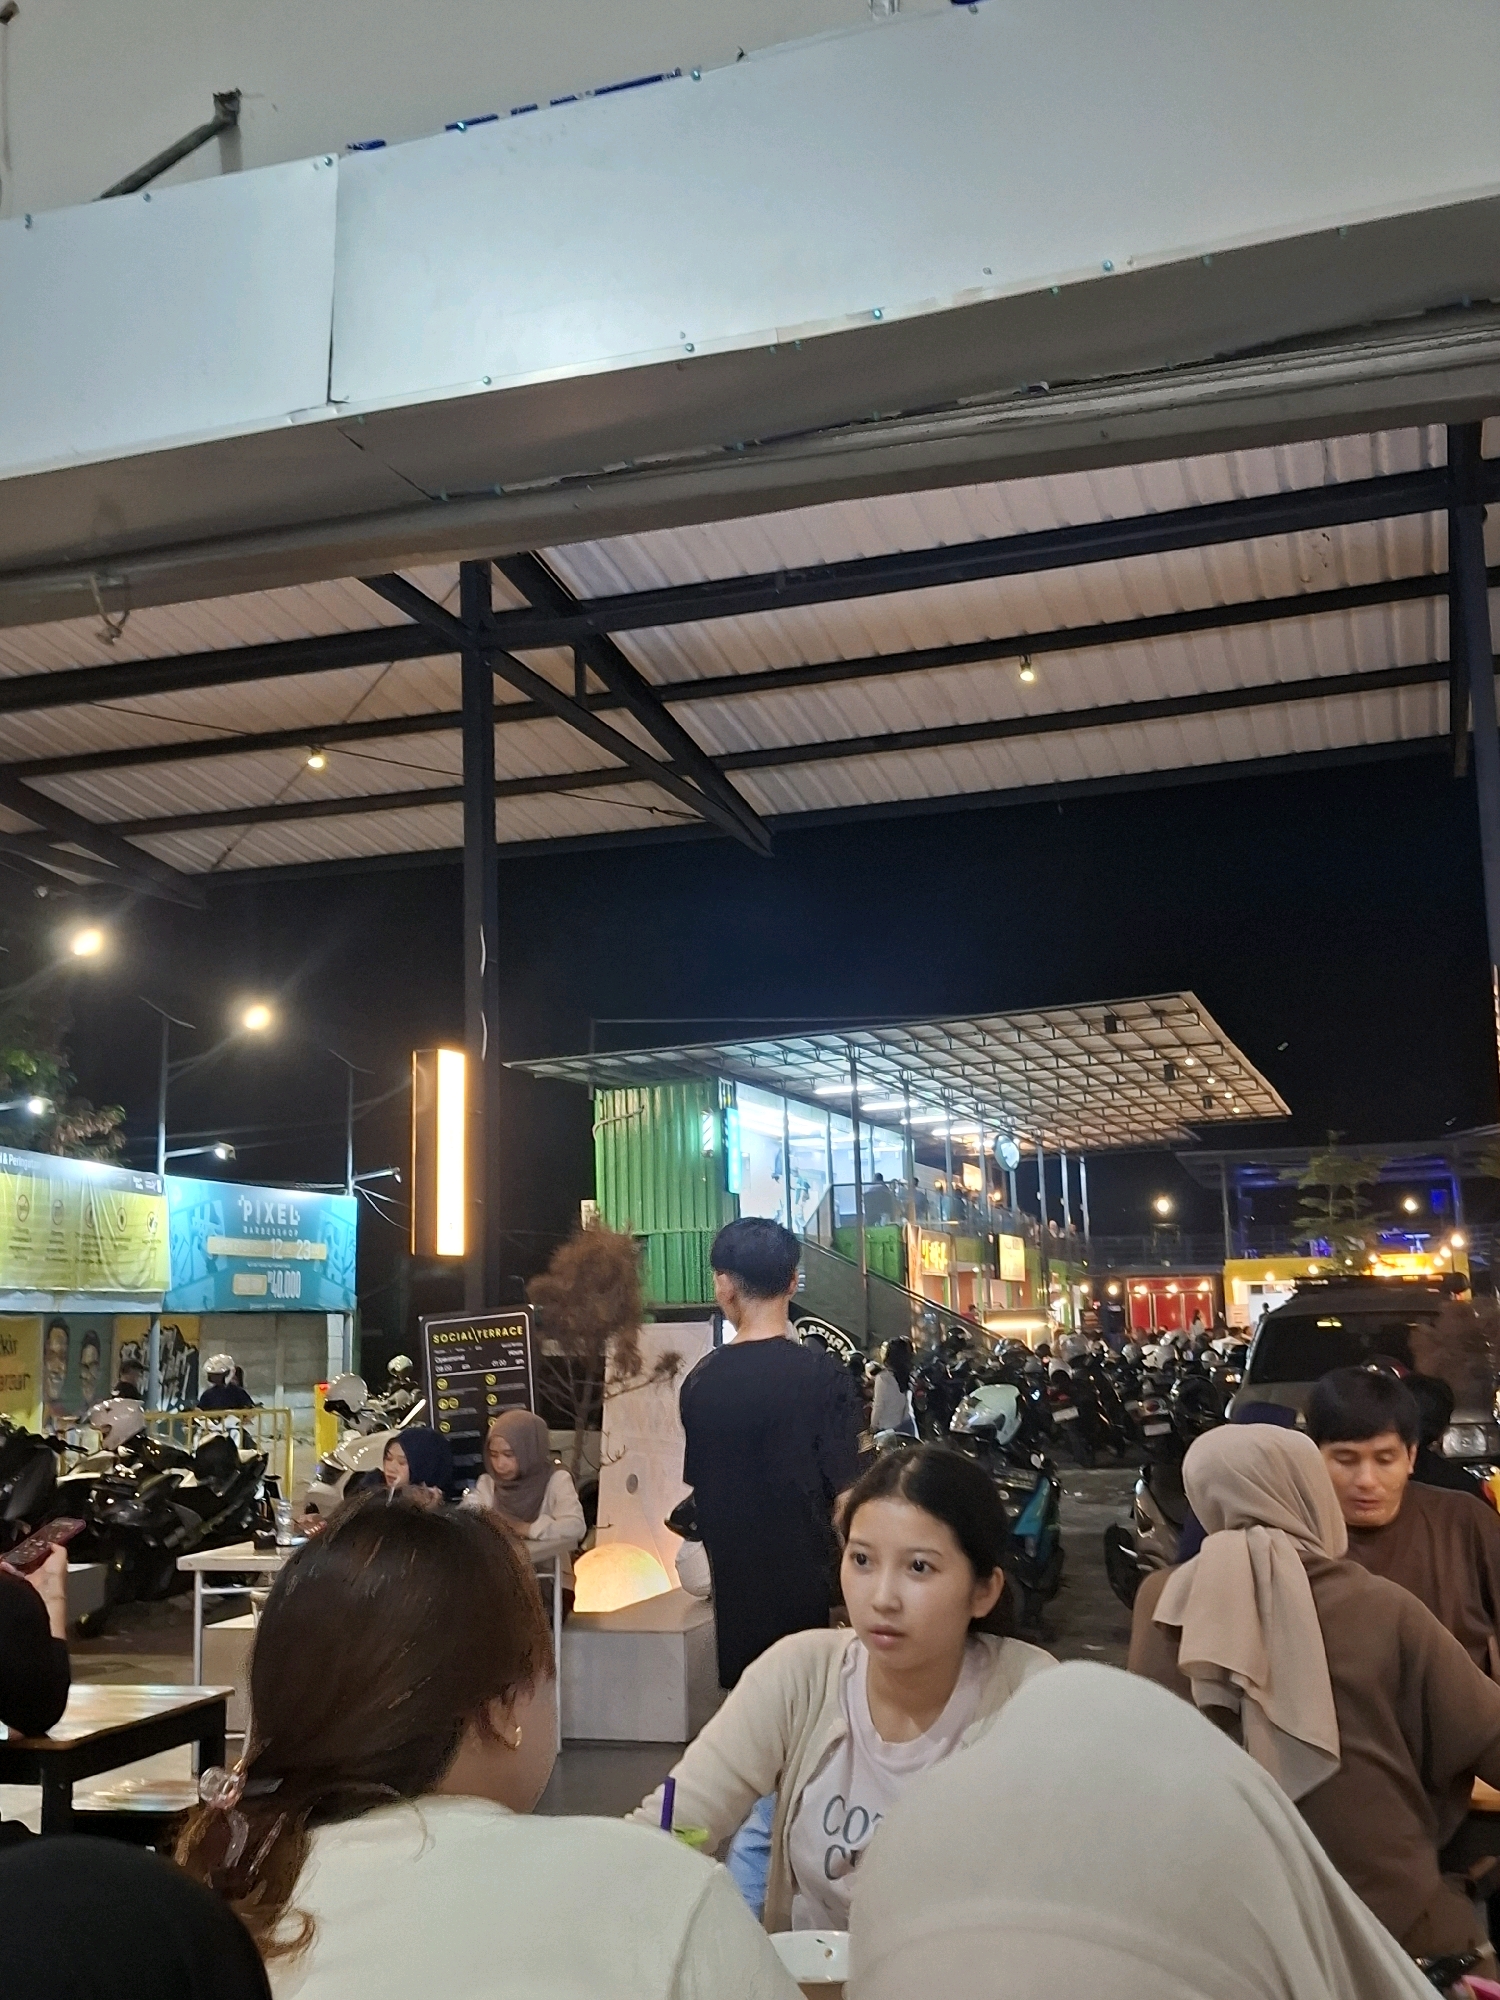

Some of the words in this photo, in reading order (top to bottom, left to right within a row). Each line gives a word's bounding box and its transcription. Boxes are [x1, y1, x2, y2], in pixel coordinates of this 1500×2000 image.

[243, 1200, 300, 1226] PIXEL
[243, 1226, 299, 1237] BARBERSHOP
[270, 1237, 283, 1260] 12
[296, 1238, 311, 1260] 23
[823, 1794, 884, 1845] CO
